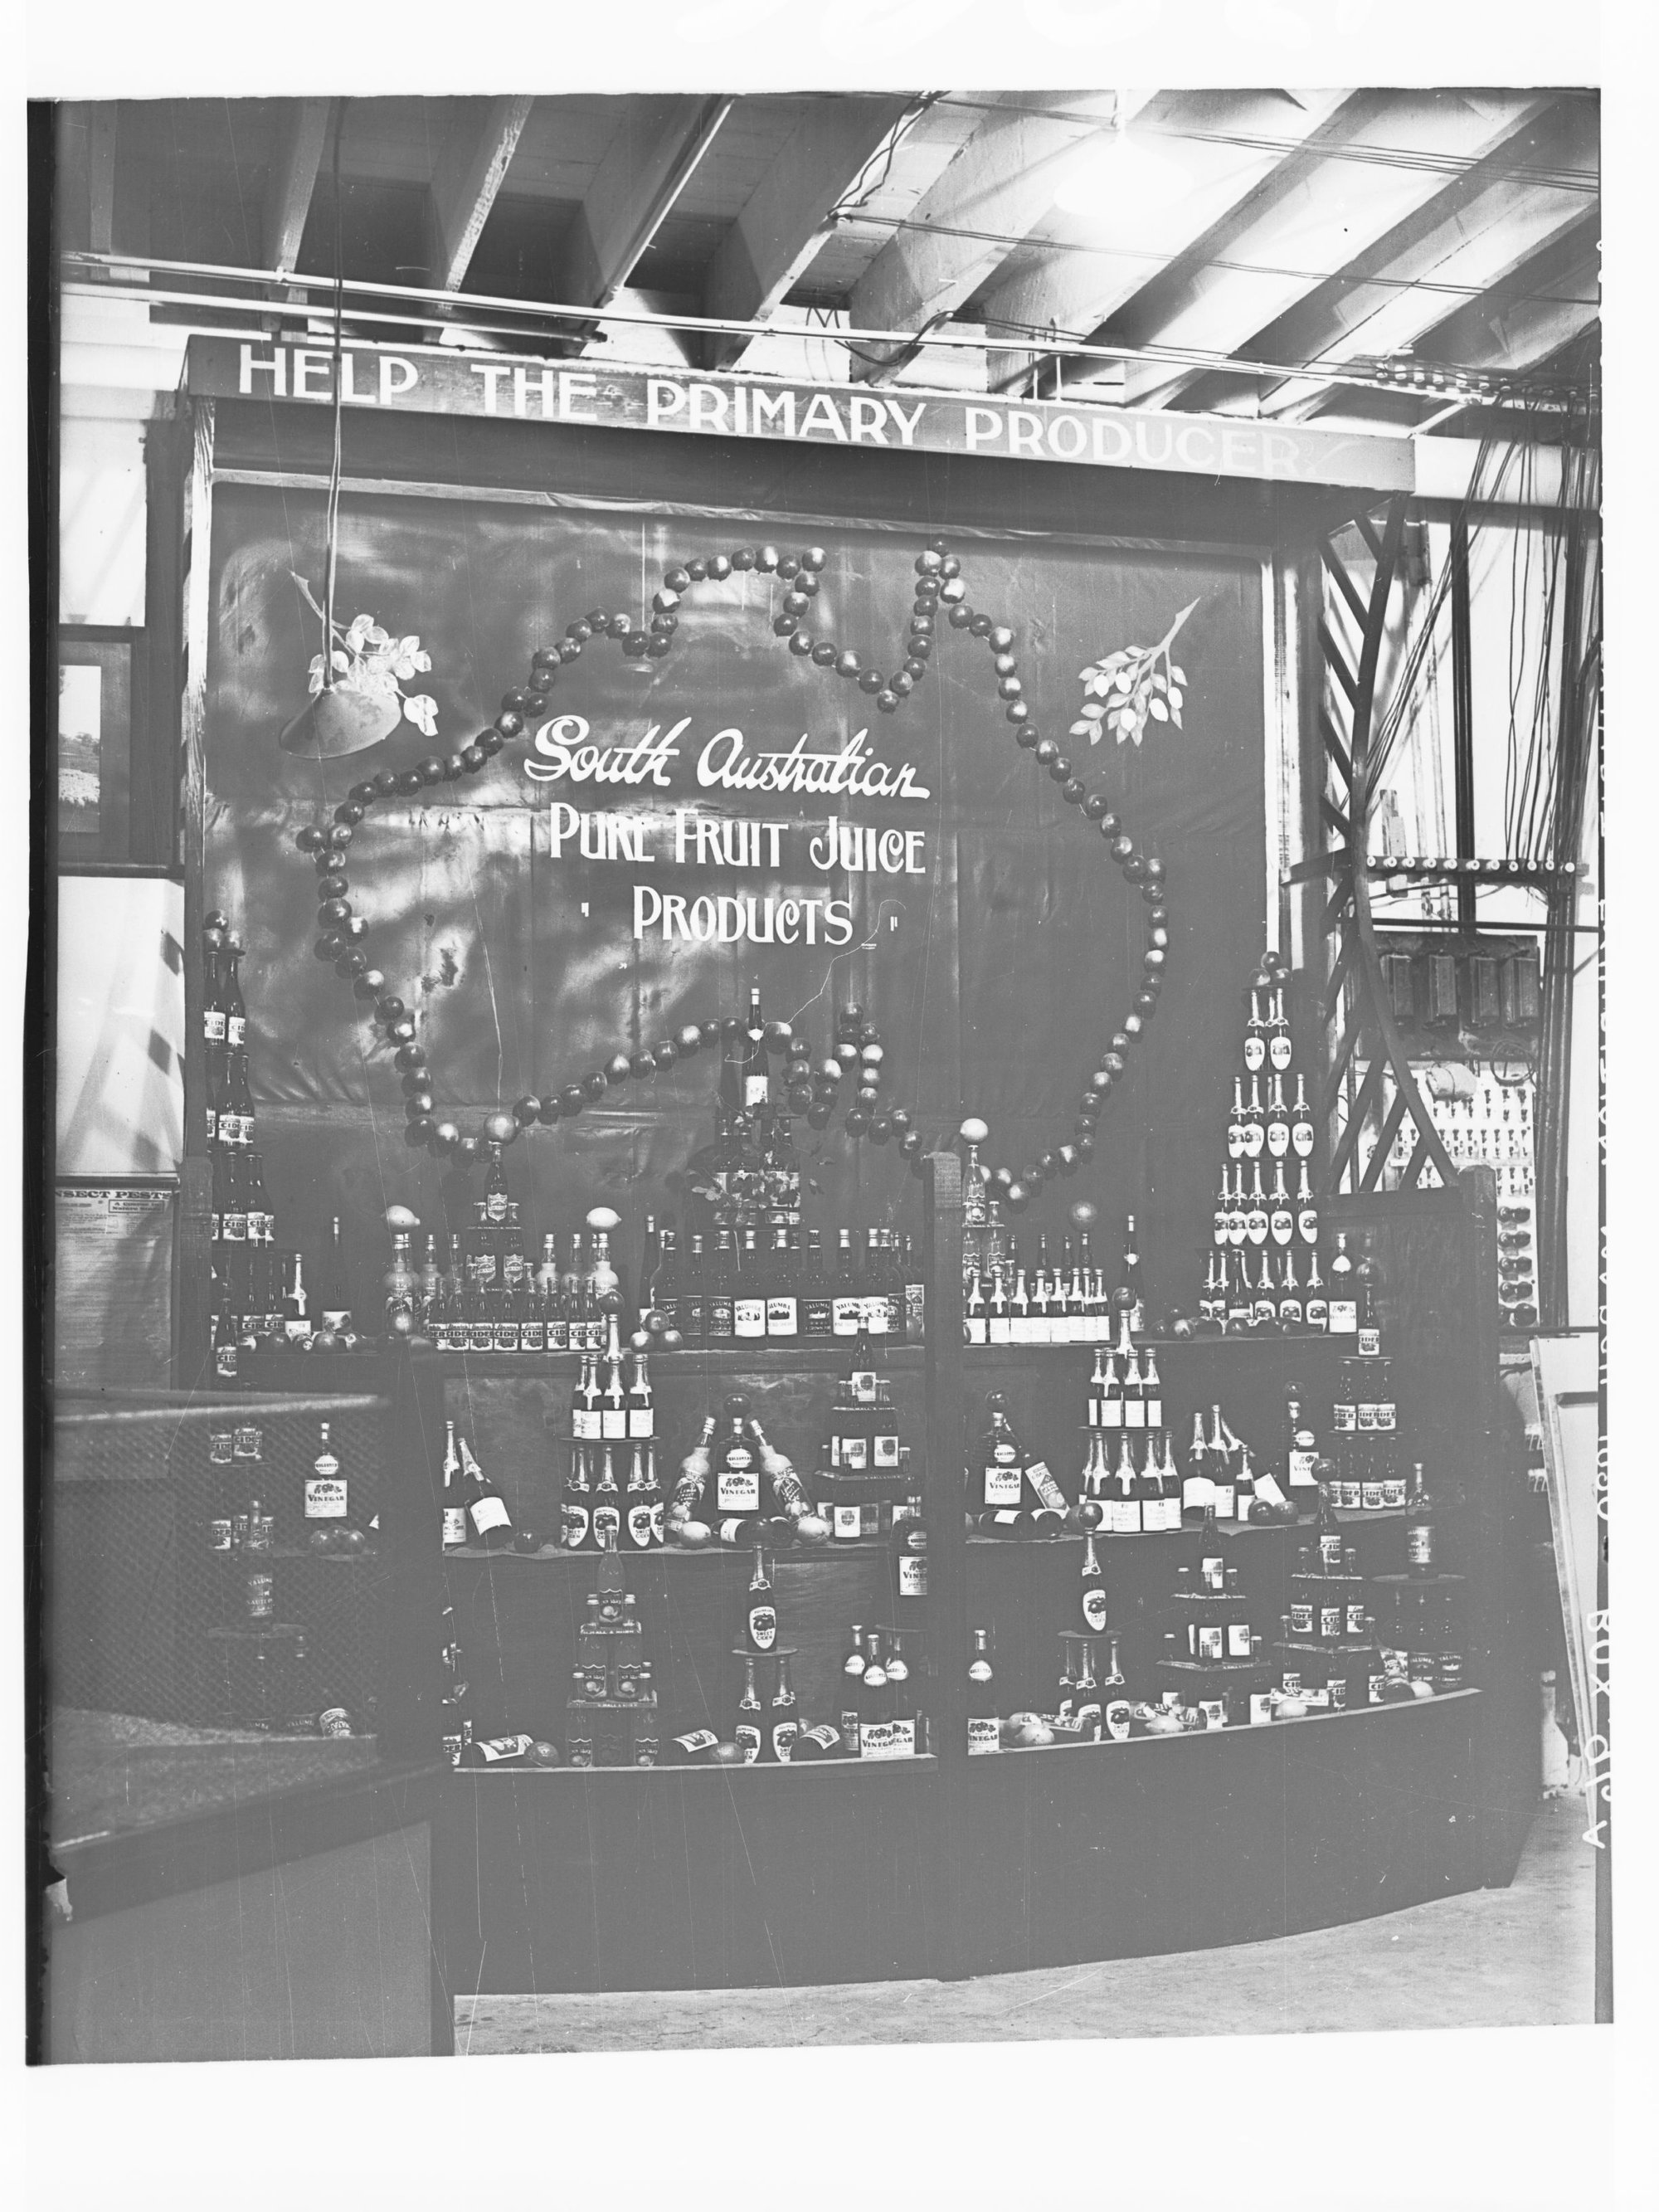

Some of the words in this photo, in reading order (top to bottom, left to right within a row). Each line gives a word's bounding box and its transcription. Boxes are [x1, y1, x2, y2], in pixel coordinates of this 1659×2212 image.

[239, 343, 418, 405] HELP
[470, 363, 597, 421] THE
[646, 379, 927, 446] PRIMARY
[966, 407, 1303, 476] PRODUCER
[523, 714, 692, 787] South
[697, 728, 931, 799] Australian
[550, 802, 654, 863] PURE
[675, 809, 788, 868] FRUIT
[810, 816, 927, 874] JUICE
[633, 885, 854, 945] PRODUCTS
[720, 1487, 757, 1495] VINEGAR
